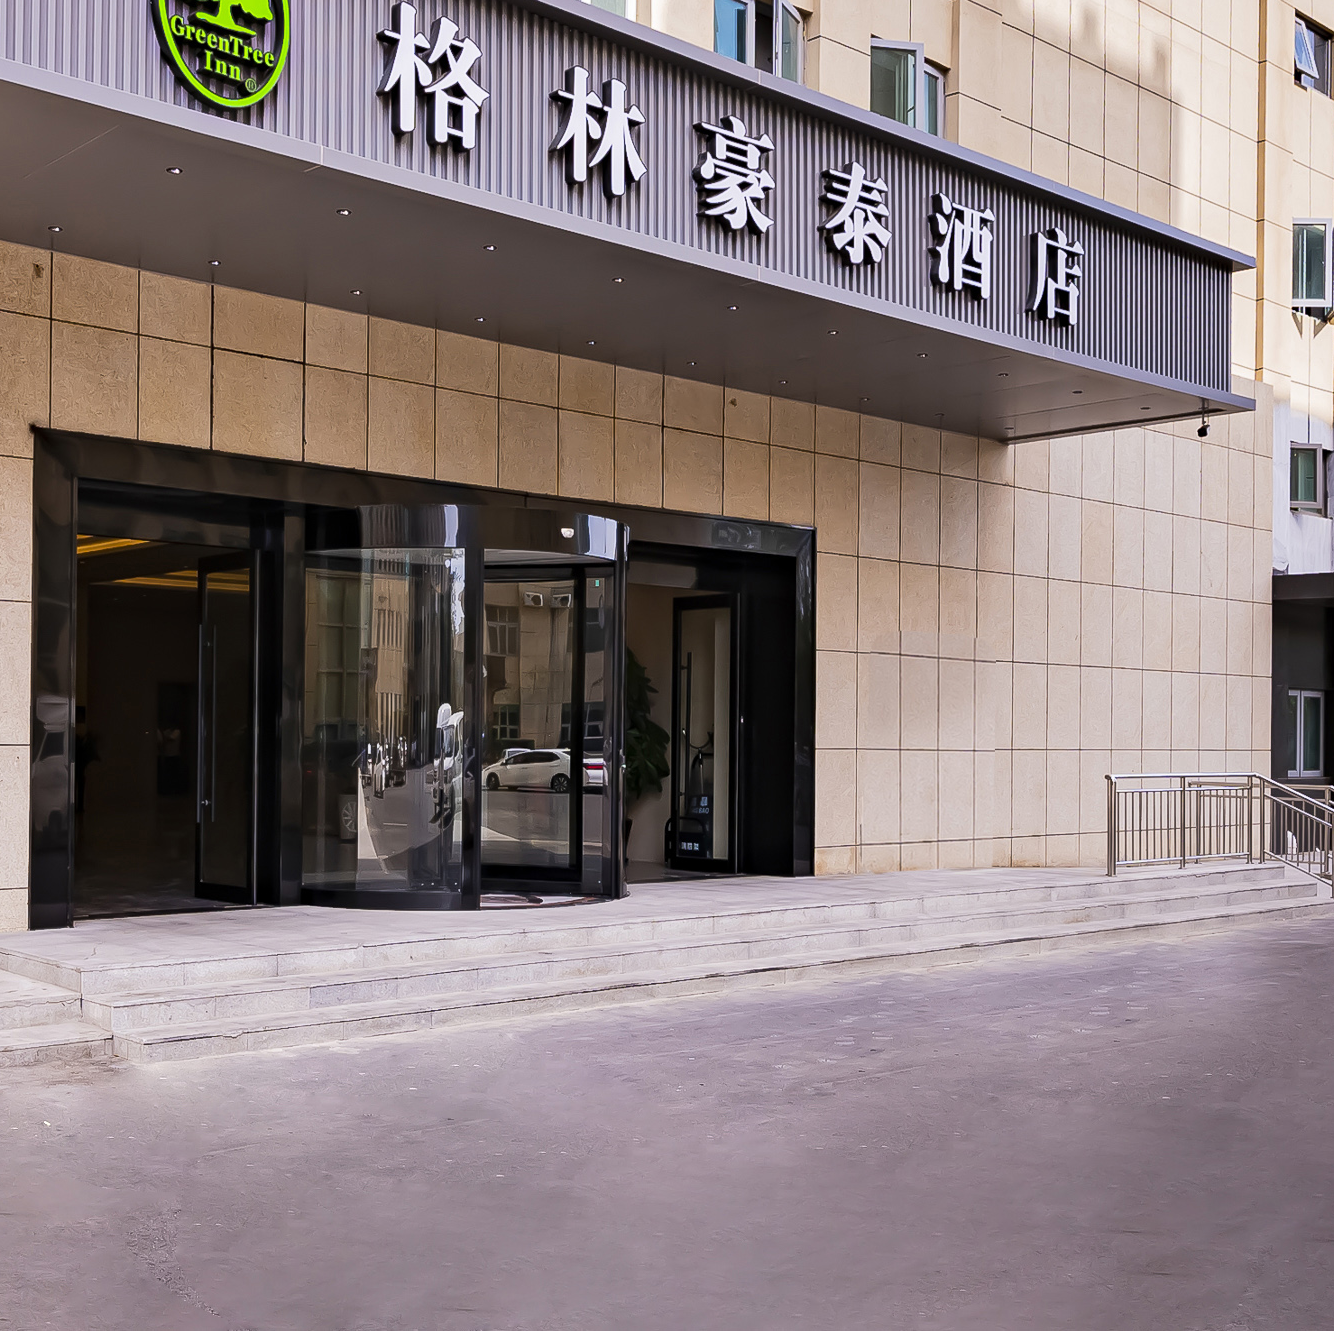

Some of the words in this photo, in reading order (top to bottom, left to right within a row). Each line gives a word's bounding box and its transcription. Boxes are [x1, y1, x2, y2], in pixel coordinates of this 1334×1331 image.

[170, 15, 275, 67] GreenTree
[204, 50, 242, 82] Inn
[379, 0, 1085, 326] 格林豪泰酒店
